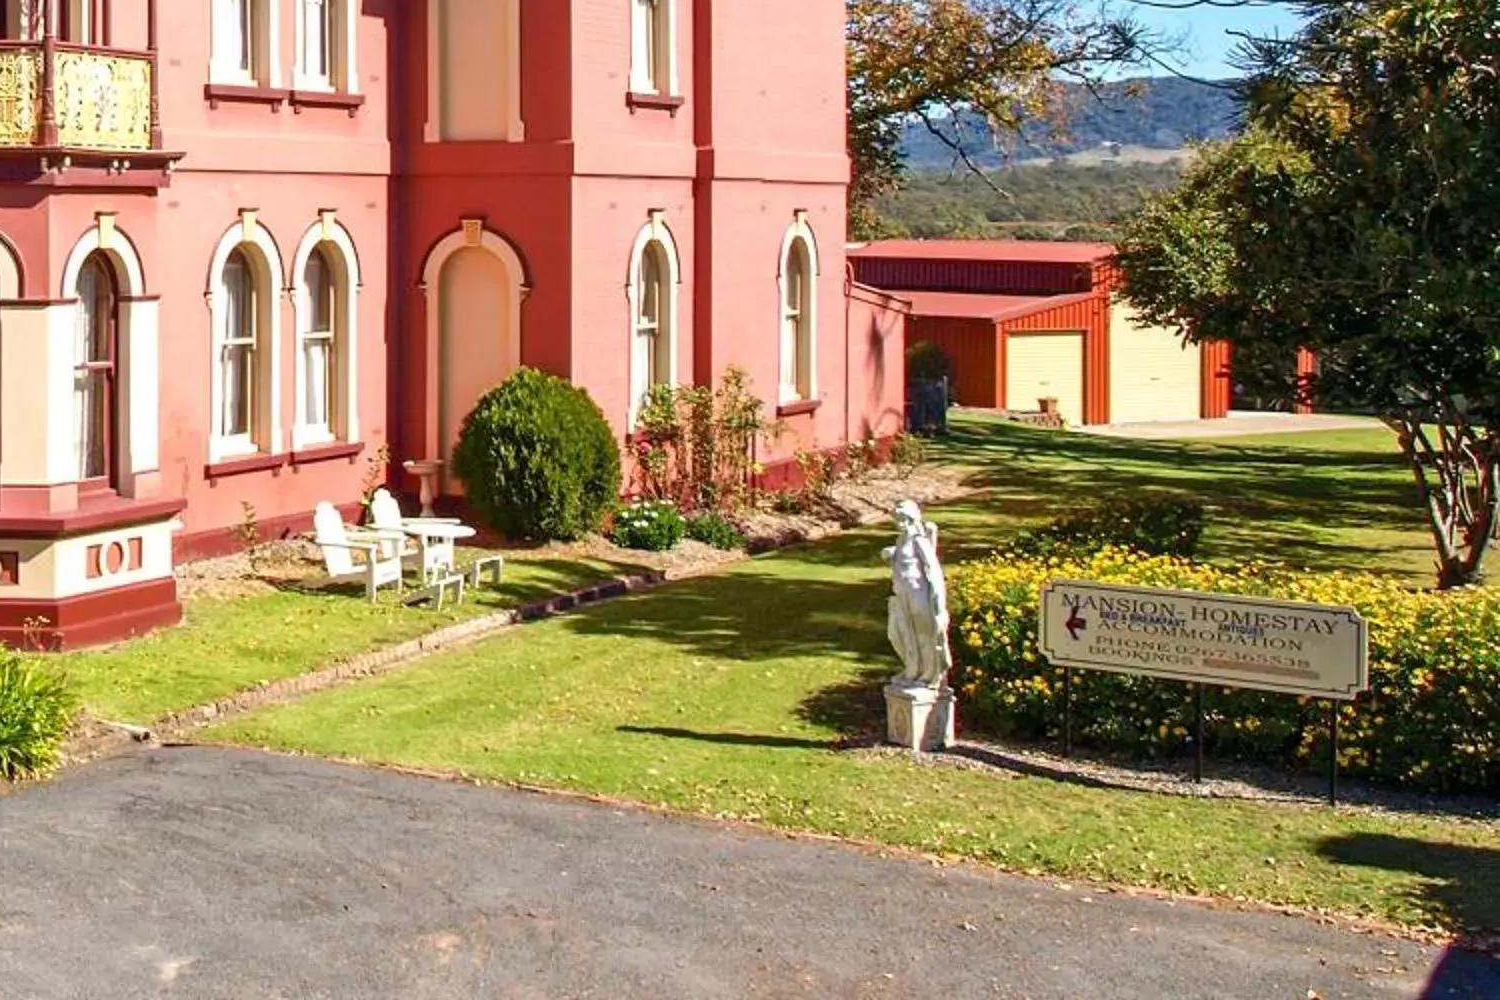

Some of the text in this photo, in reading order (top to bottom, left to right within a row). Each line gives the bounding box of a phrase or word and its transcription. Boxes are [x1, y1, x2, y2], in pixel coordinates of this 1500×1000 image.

[1192, 605, 1337, 634] HOMESTAY
[1095, 635, 1169, 652] PHONE
[1098, 620, 1302, 651] ACCOMMODATION
[1088, 645, 1194, 665] BOOKINGS
